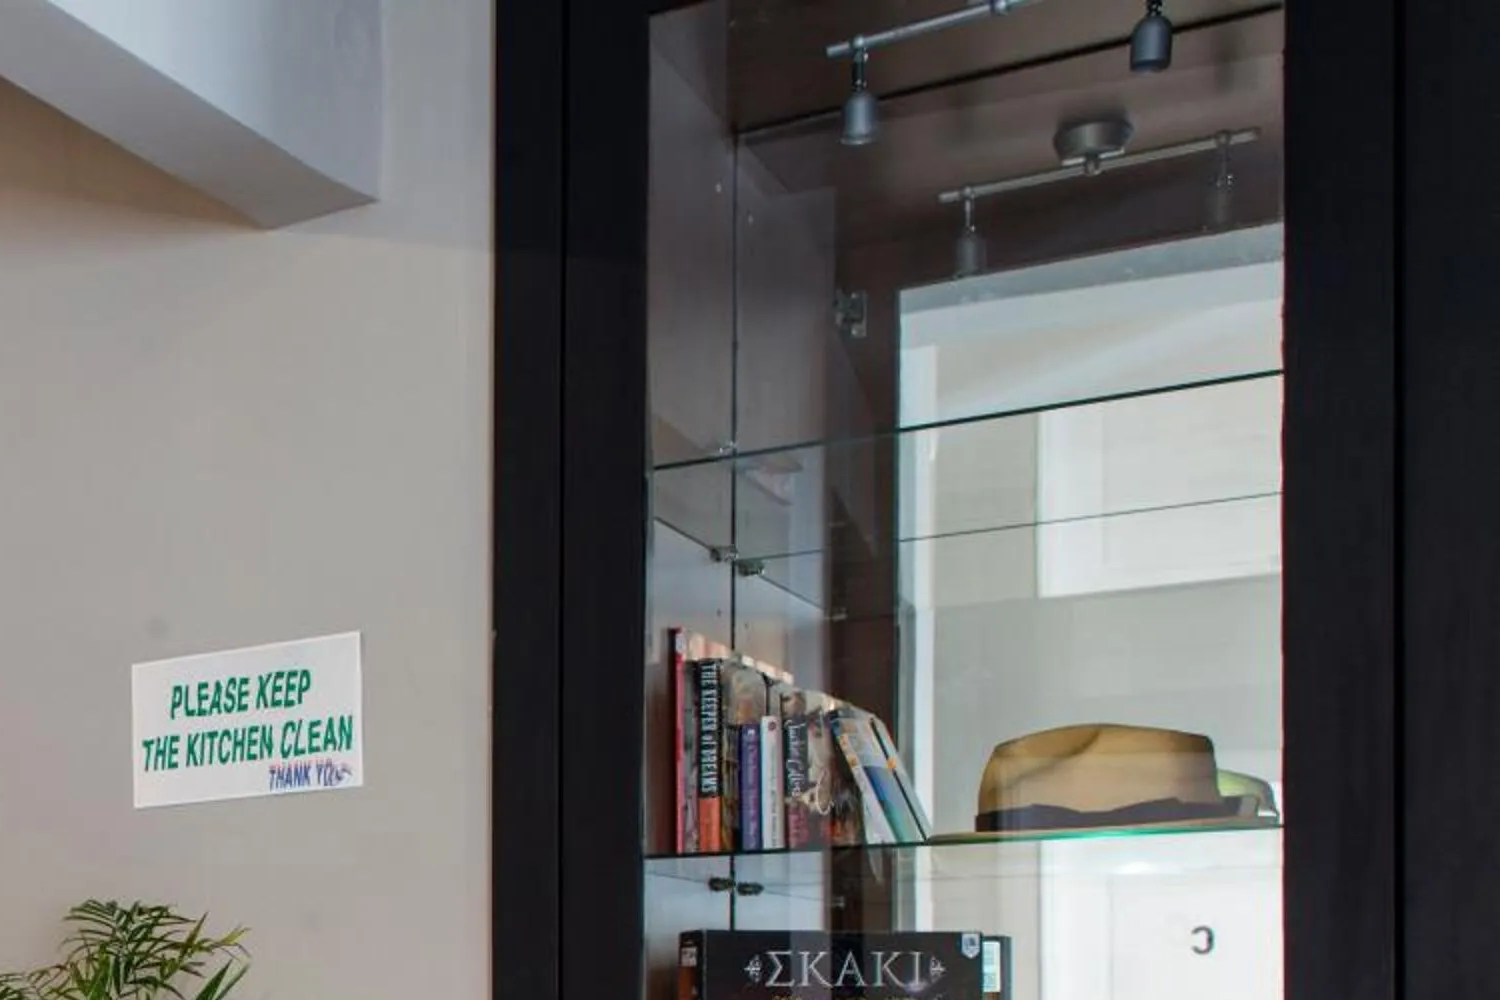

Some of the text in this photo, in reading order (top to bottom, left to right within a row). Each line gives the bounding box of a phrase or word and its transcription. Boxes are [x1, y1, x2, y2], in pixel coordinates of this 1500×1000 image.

[701, 664, 718, 686] THE
[170, 669, 311, 720] PLEASE KEEP
[142, 715, 353, 772] THE KITCHEN CLEAN
[269, 763, 311, 792] THANK
[765, 951, 924, 988] ΣΚΑΚΙ
